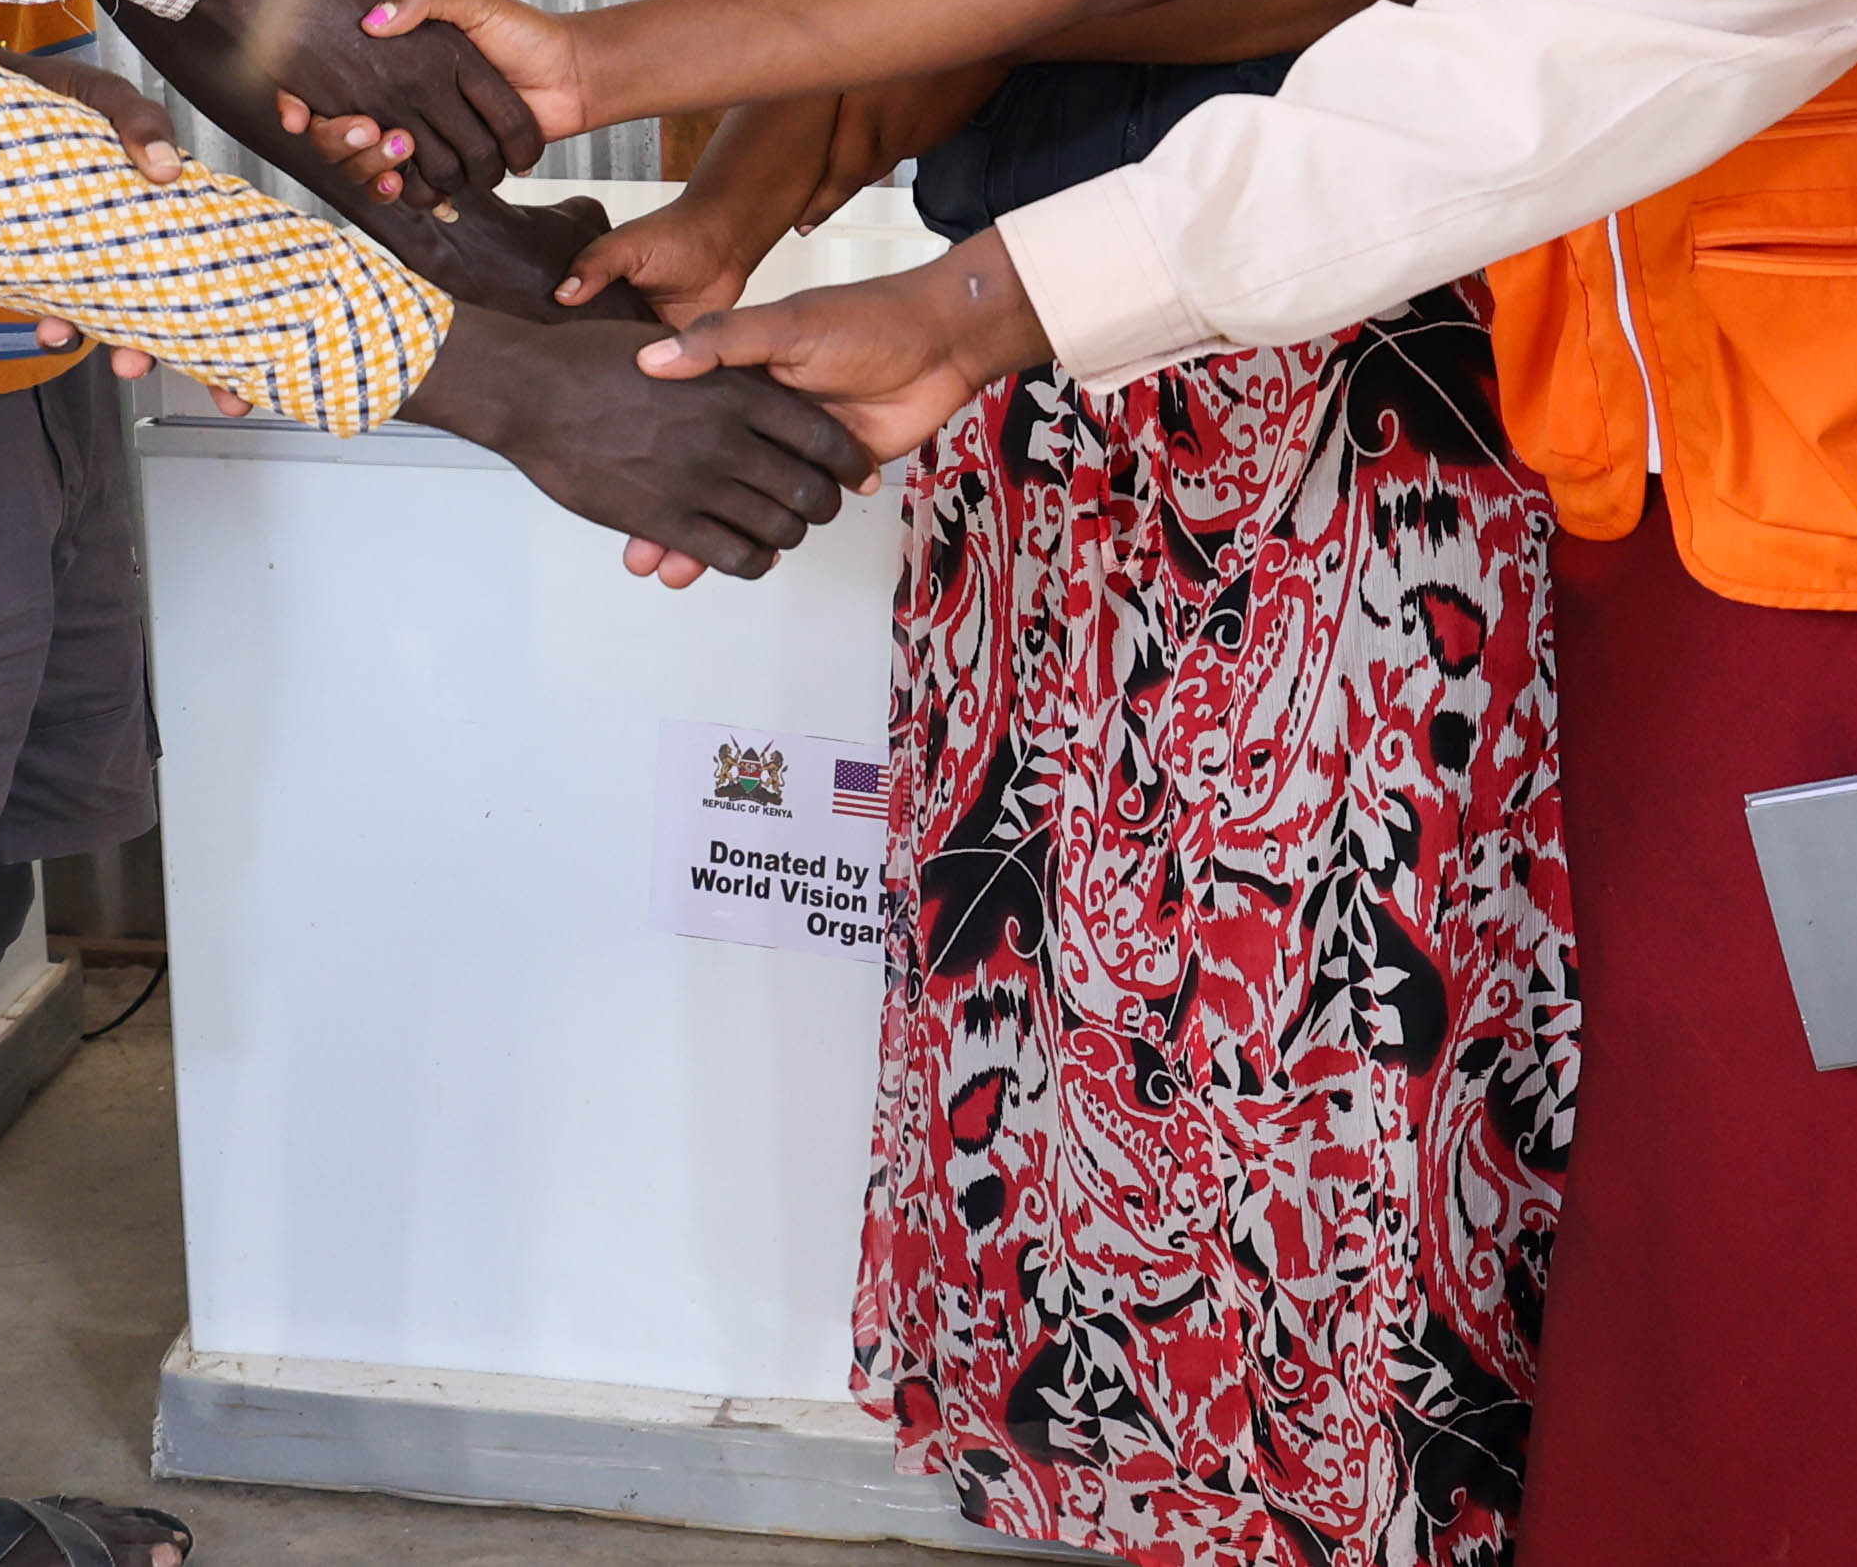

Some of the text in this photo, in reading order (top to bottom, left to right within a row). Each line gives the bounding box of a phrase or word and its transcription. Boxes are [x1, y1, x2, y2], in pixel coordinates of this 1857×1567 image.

[702, 798, 747, 813] REPUBLIC
[748, 804, 761, 815] OF
[762, 806, 793, 819] KENYA
[709, 840, 827, 879] Donated
[836, 857, 870, 890] by
[690, 866, 771, 900] World
[780, 879, 868, 914] Vision
